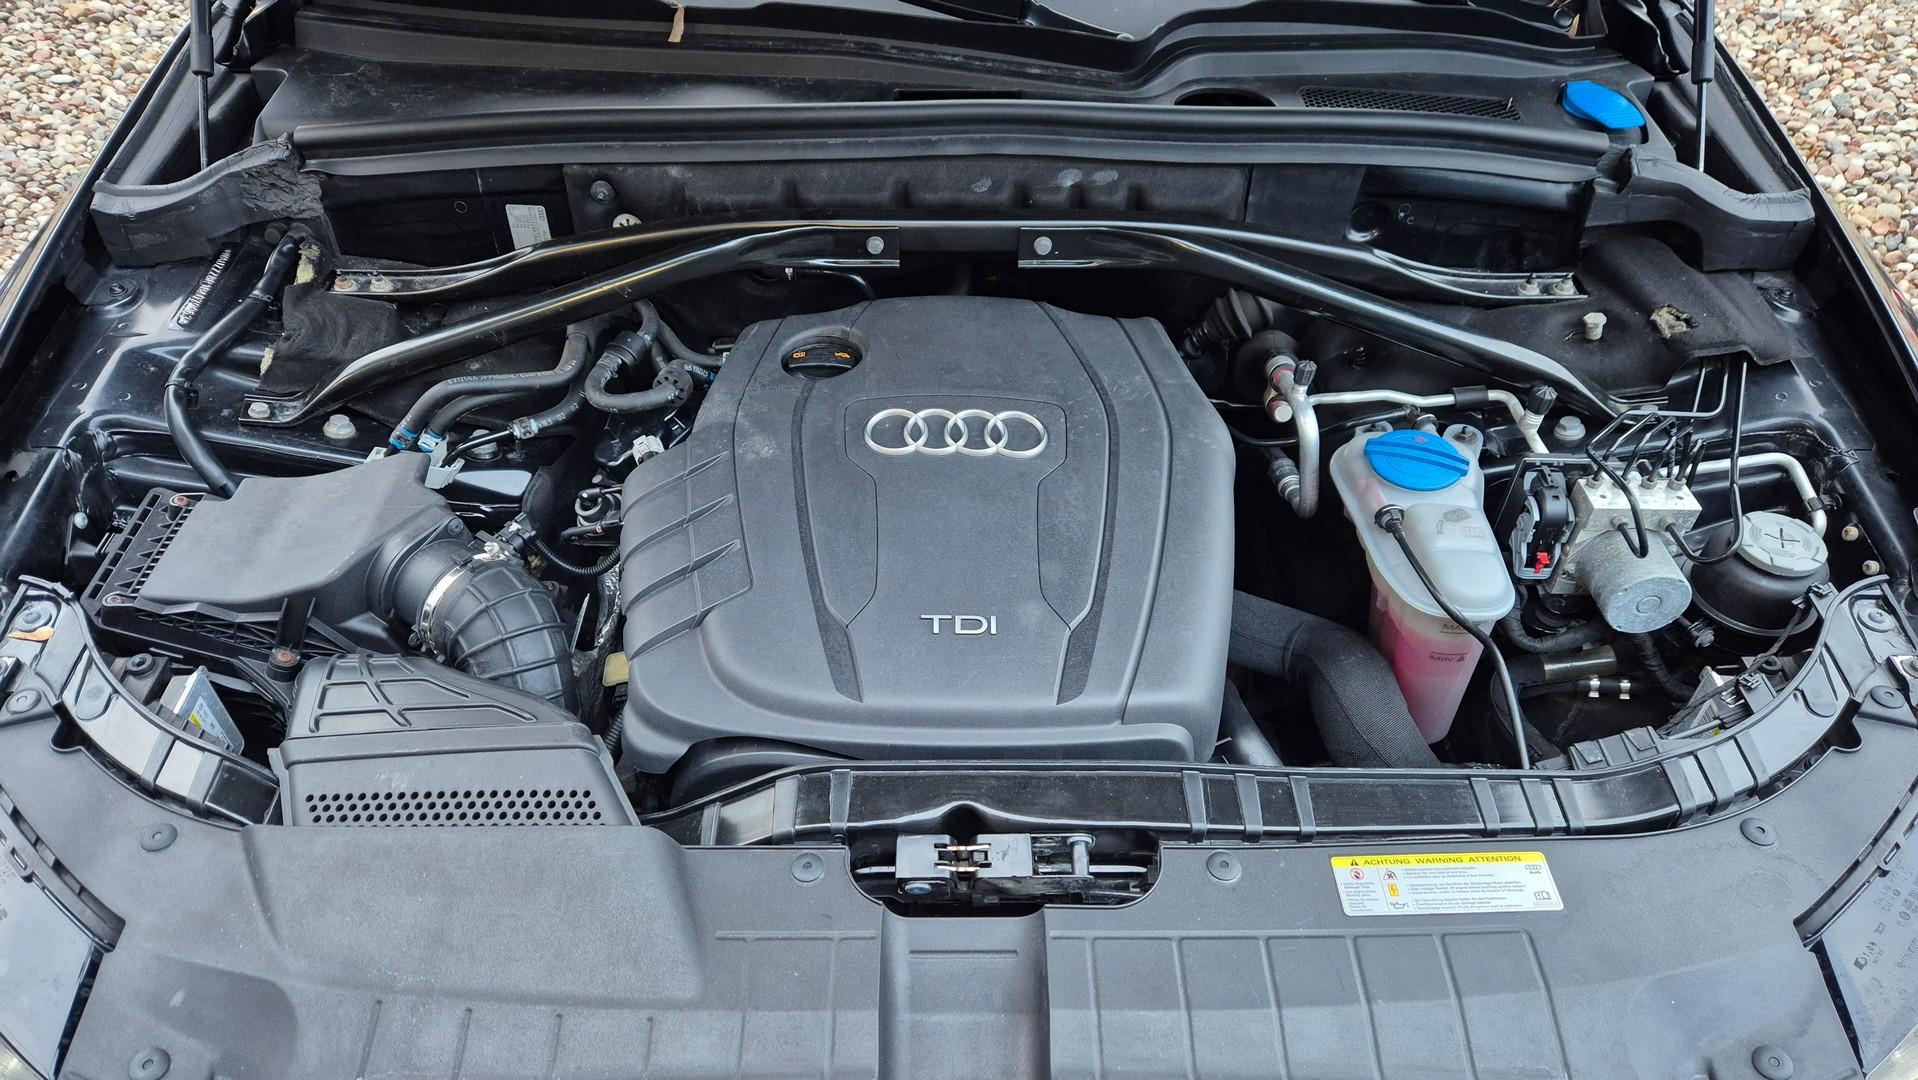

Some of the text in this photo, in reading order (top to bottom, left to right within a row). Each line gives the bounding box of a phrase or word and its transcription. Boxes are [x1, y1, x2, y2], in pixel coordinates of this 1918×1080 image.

[920, 614, 997, 635] TDI
[1428, 654, 1454, 663] MIN
[1363, 855, 1522, 866] ACHTUNG WARNING ATTENTION
